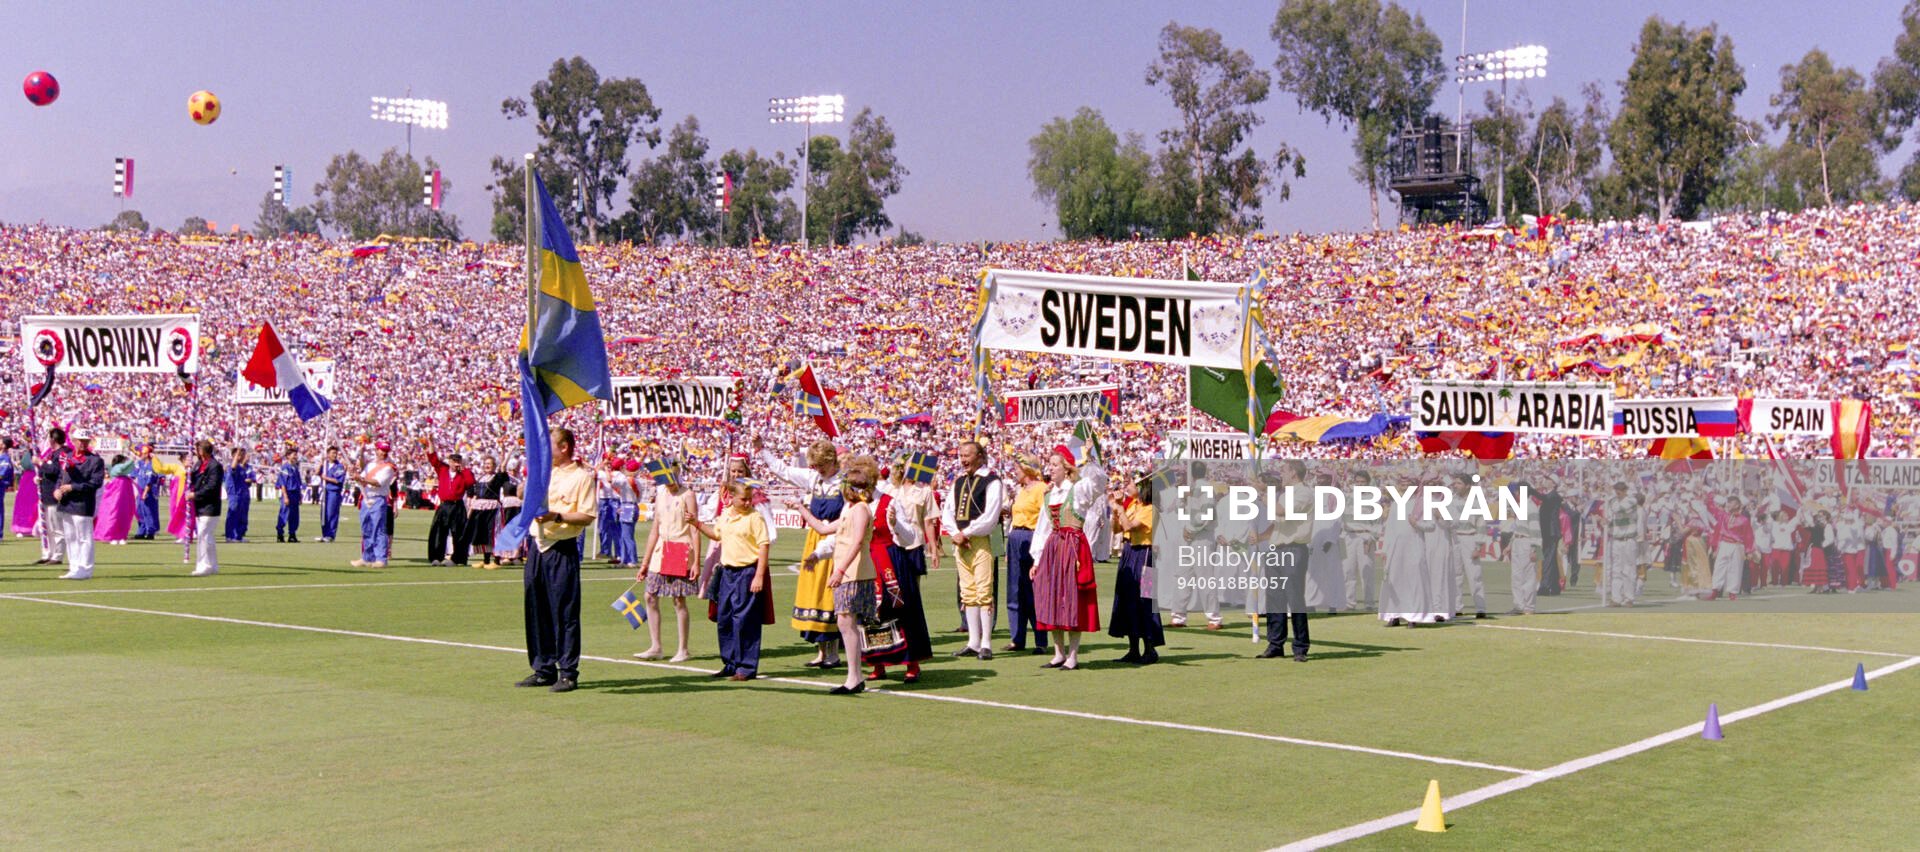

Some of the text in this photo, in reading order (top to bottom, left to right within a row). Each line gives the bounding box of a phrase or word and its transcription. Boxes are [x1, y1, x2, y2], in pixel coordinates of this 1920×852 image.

[1041, 289, 1191, 357] SWEDEN
[64, 327, 162, 367] NORWAY
[1420, 390, 1605, 430] SAUDI ARABIA
[1622, 407, 1699, 434] RUSSIA
[1770, 406, 1824, 430] SPAIN
[1191, 439, 1243, 459] NIGERIA
